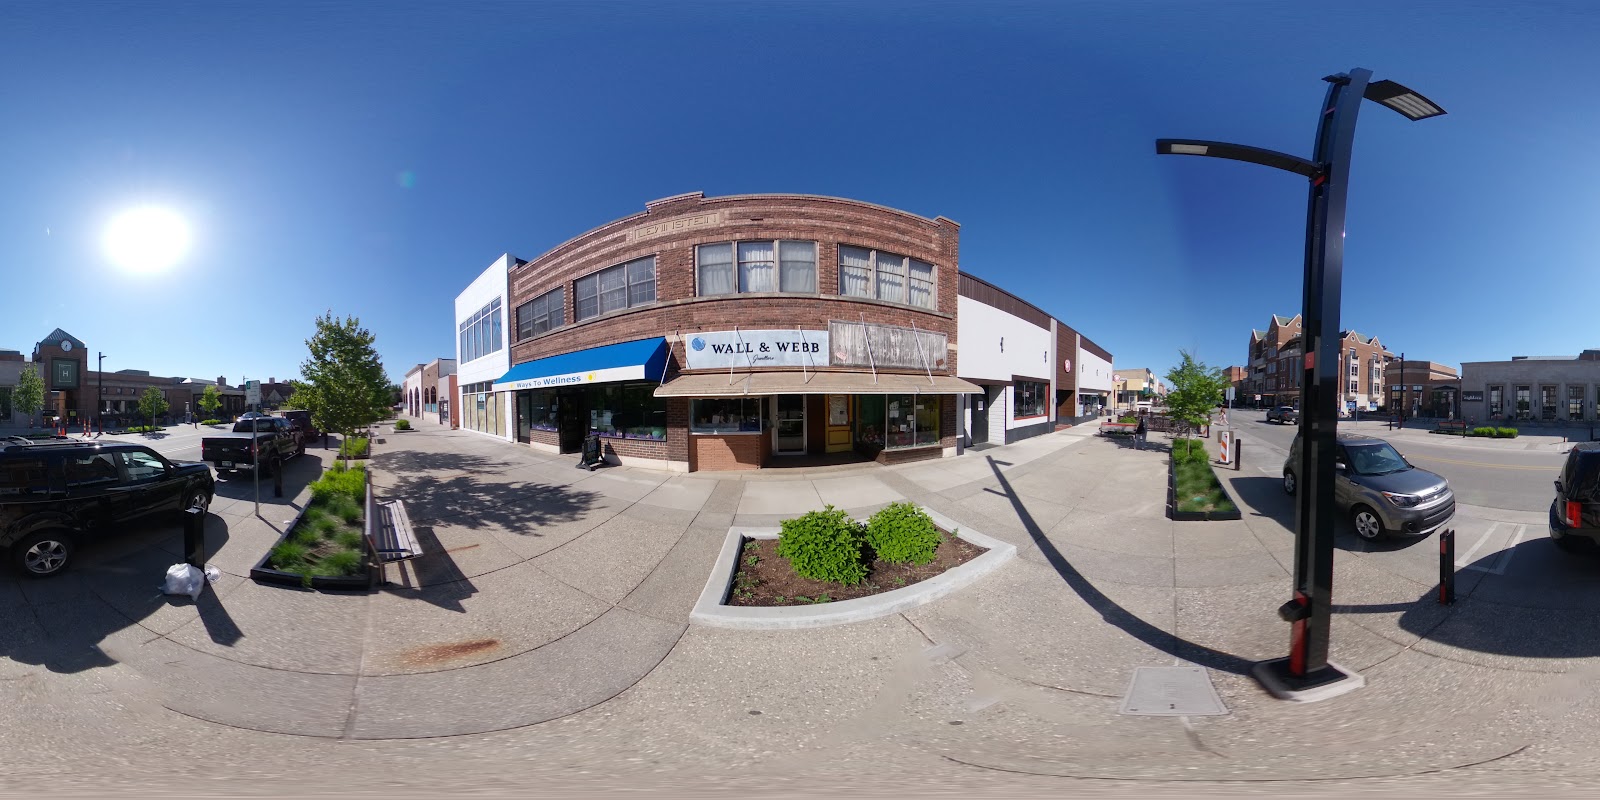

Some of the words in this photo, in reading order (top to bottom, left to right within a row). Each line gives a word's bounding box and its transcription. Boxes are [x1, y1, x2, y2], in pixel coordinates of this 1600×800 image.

[712, 343, 753, 354] WALL
[759, 342, 771, 353] &
[775, 342, 820, 353] WEBB
[544, 376, 581, 385] Wellness
